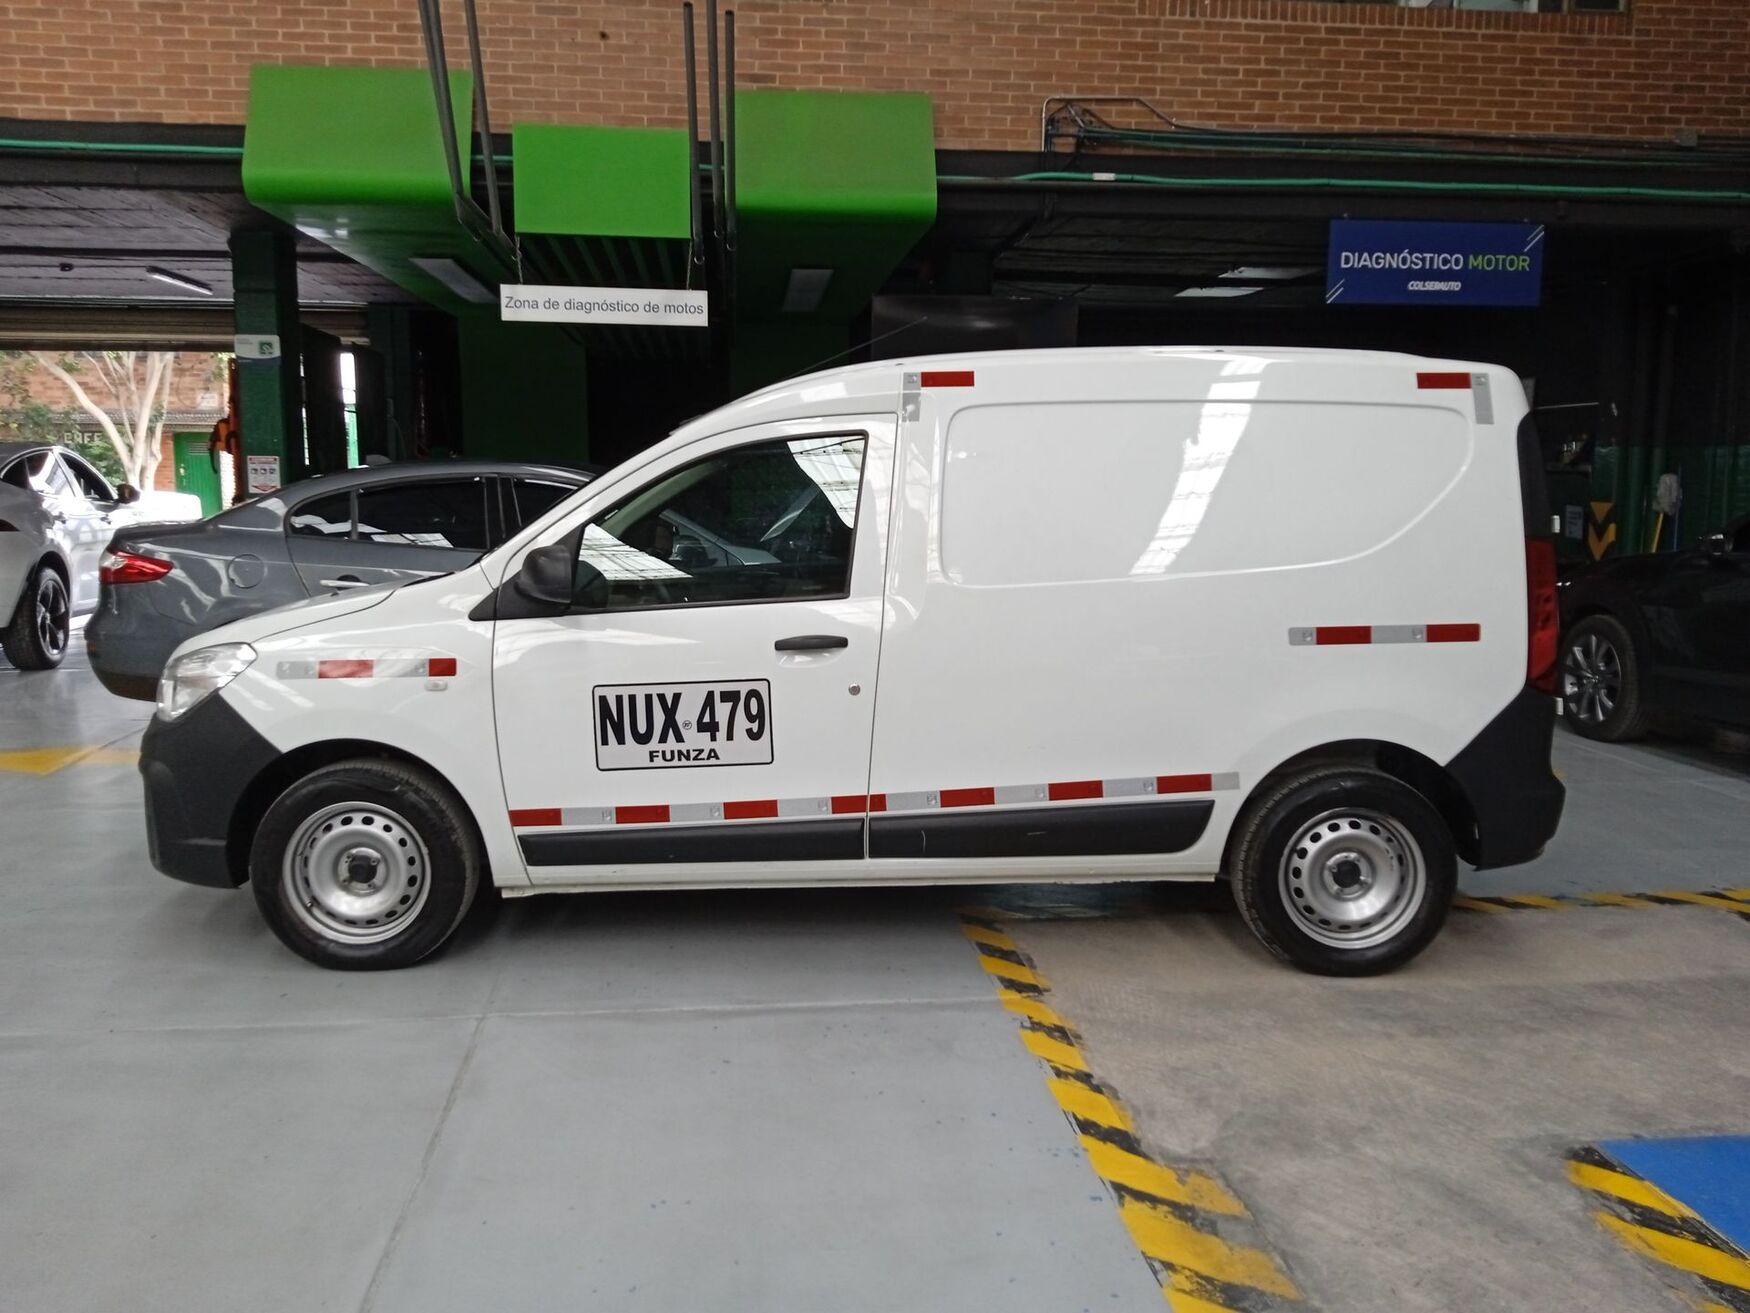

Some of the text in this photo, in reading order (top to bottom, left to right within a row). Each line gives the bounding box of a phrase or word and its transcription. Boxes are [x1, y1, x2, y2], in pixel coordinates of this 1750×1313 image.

[1340, 249, 1530, 271] DIAGNÓSTICO MOTOR
[504, 296, 704, 315] Zona de diagnóstico de motos
[598, 688, 766, 746] NUX 479
[648, 748, 720, 763] FUNZA
